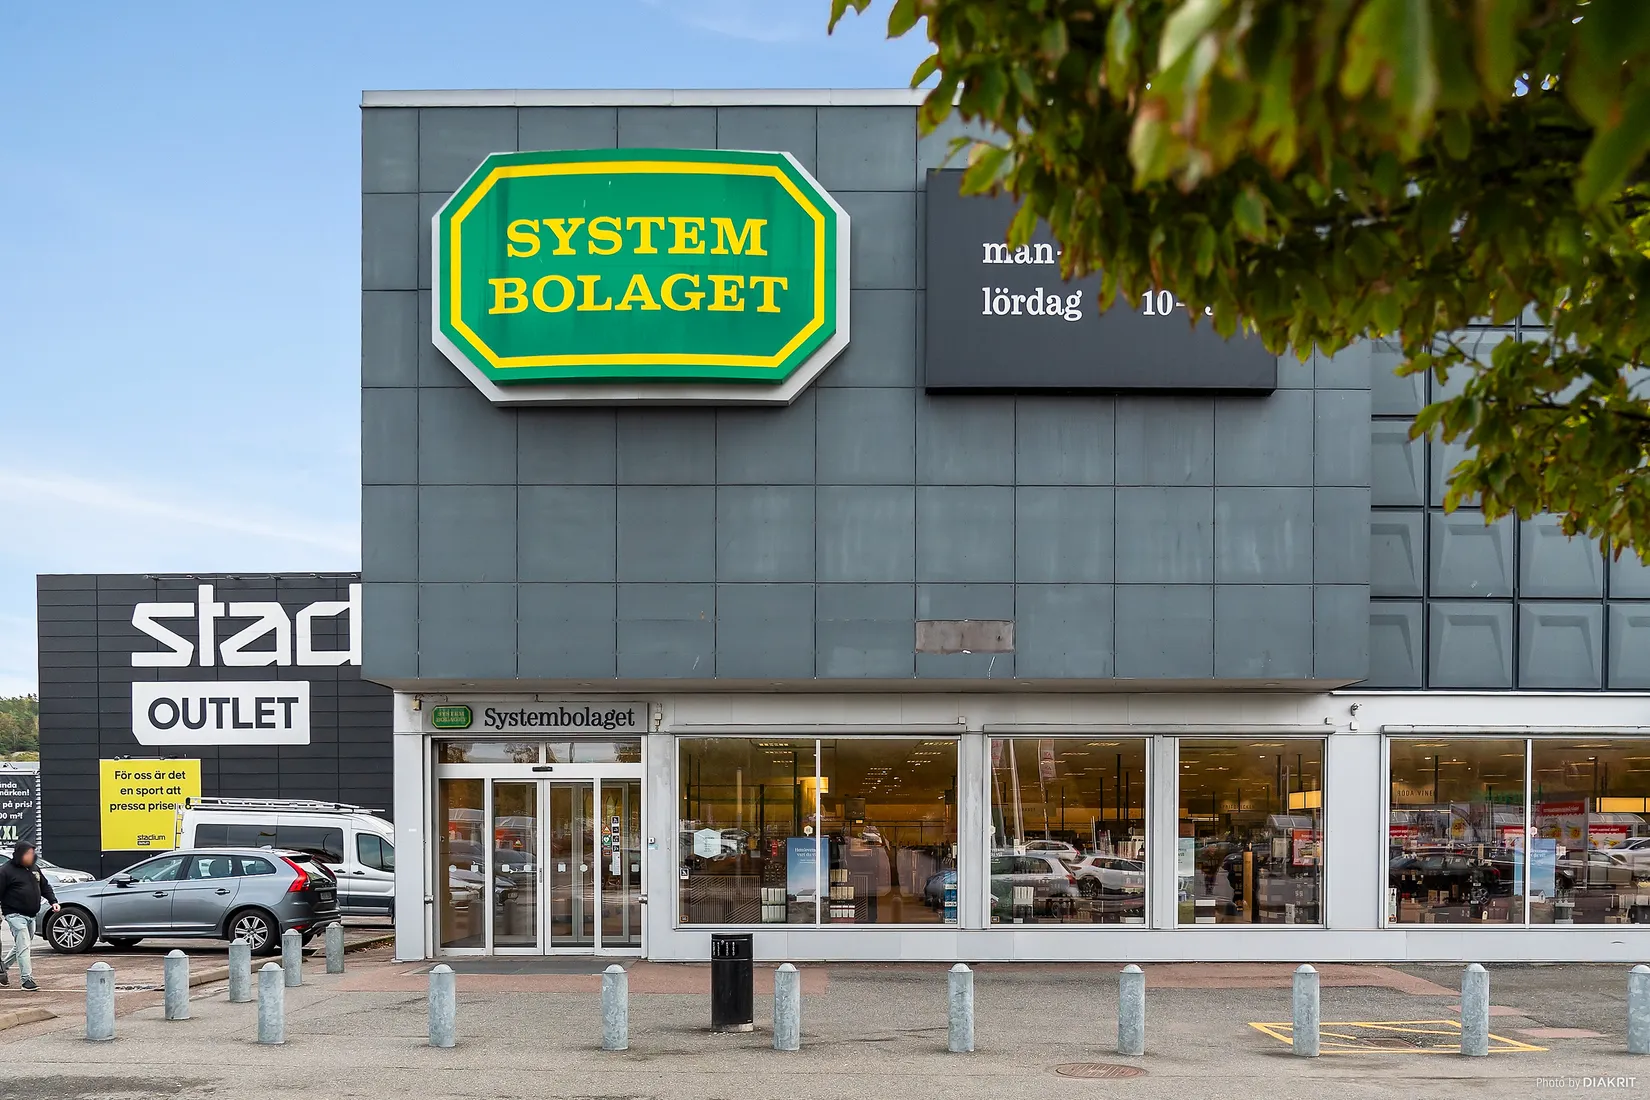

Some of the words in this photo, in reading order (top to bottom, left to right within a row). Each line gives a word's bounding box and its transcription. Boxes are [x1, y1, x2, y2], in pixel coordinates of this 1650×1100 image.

[506, 216, 768, 258] SYSTEM
[488, 273, 788, 315] BOLAGET
[982, 287, 1083, 321] lördag
[1142, 290, 1213, 316] 10-
[131, 583, 362, 667] stad
[147, 697, 299, 730] OUTLET
[484, 707, 635, 730] Systembolaget
[114, 771, 132, 780] För
[134, 772, 152, 780] oss
[154, 771, 166, 780] är
[168, 771, 186, 780] det
[120, 787, 134, 795] en
[136, 786, 164, 797] sport
[166, 786, 181, 795] att
[2, 800, 13, 809] på
[14, 801, 33, 809] pris!
[109, 803, 145, 812] pressa
[0, 826, 19, 840] XL
